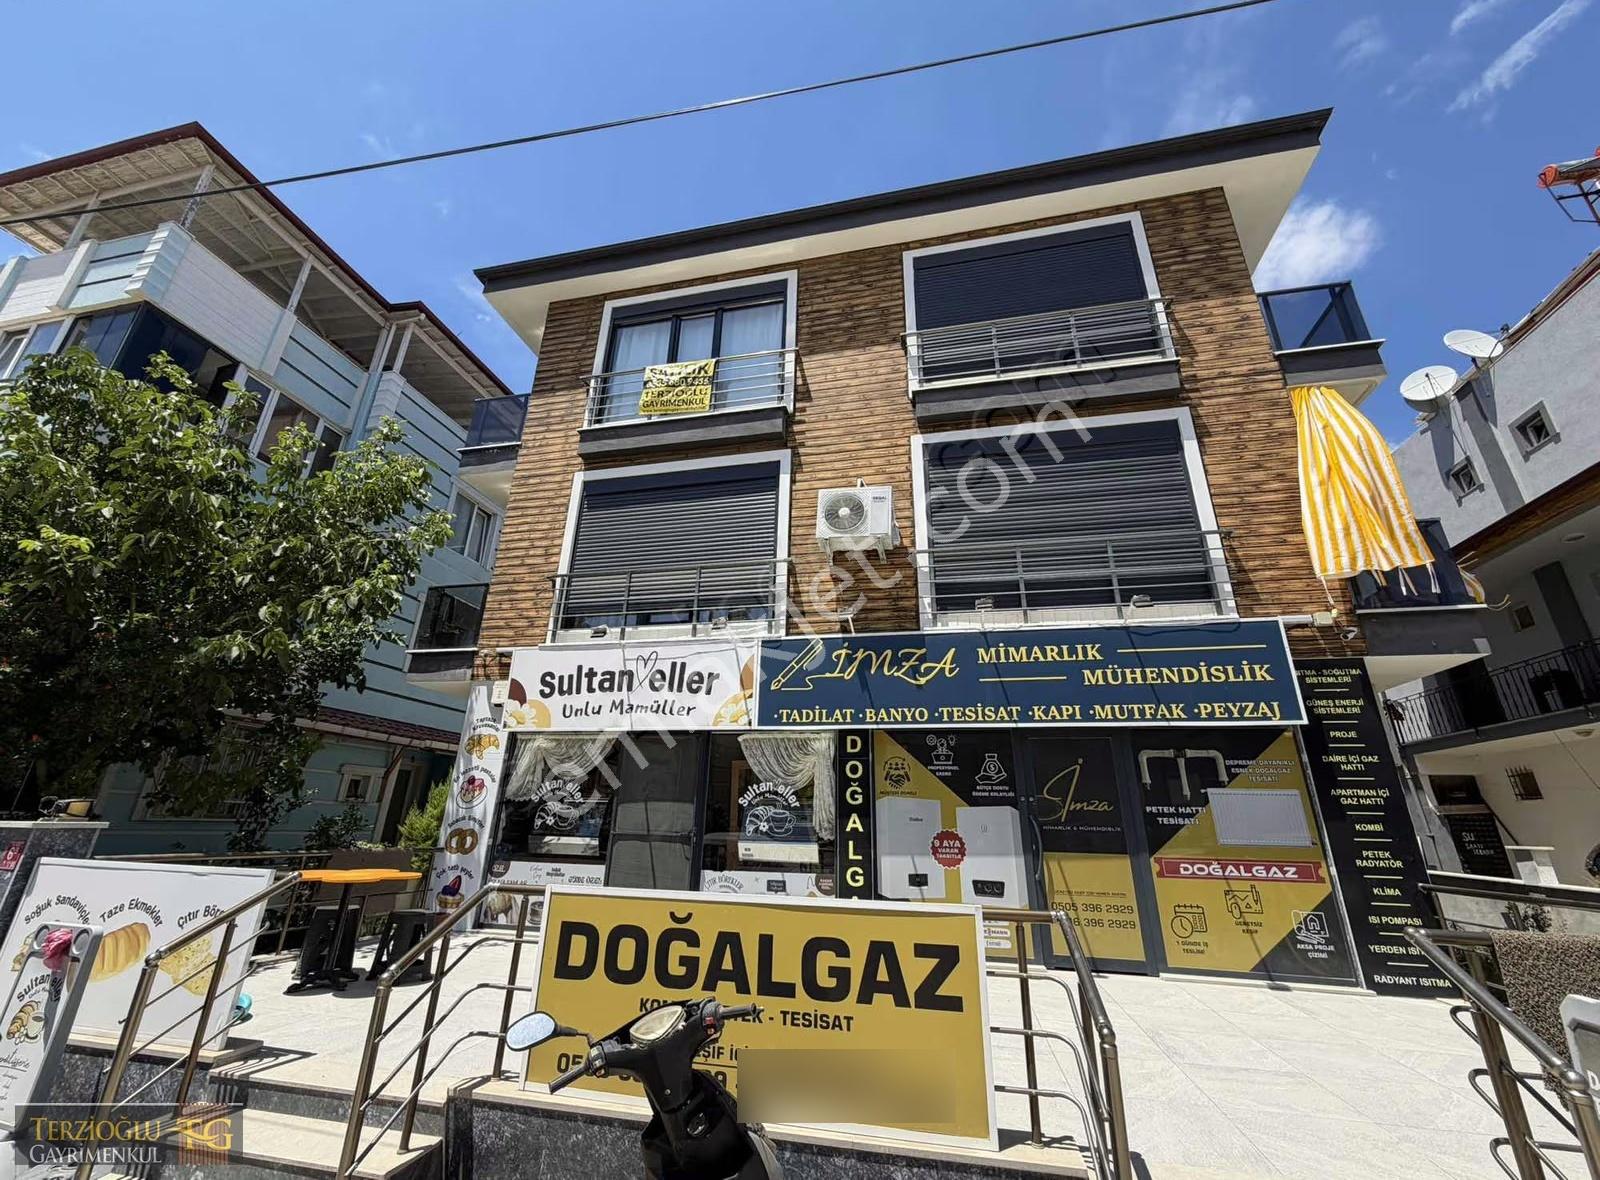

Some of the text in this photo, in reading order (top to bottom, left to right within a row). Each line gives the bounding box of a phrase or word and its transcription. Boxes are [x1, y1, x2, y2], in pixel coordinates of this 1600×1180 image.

[977, 643, 1104, 664] MİMARLIK
[1082, 661, 1275, 686] MÜHENDİSLİK
[562, 698, 696, 719] Unlu Mamüller
[1322, 754, 1347, 762] DAİRE
[1361, 755, 1380, 763] GAZ
[1340, 763, 1365, 771] HATTI
[1330, 788, 1377, 796] APARTMAN
[1340, 797, 1384, 805] GAZ HATTI
[1157, 817, 1199, 825] TESİSATI
[1355, 822, 1384, 832] KOMBİ
[1362, 850, 1392, 859] PETEK
[1355, 858, 1404, 868] RADYATÖR
[1180, 861, 1298, 878] DOĞALGAZ
[1373, 886, 1402, 896] KLİMA
[100, 898, 163, 928] Taze Ekmekler
[1051, 901, 1134, 914] 0505 396 2929
[1084, 919, 1105, 928] 396
[1107, 919, 1136, 929] 2929
[1368, 915, 1422, 926] ISI POMPASI
[1368, 944, 1406, 955] YERDEN
[553, 911, 964, 1013] DOĞALGAZ
[1374, 974, 1452, 988] RADYANT ISITMA
[780, 1009, 853, 1032] TESİSAT
